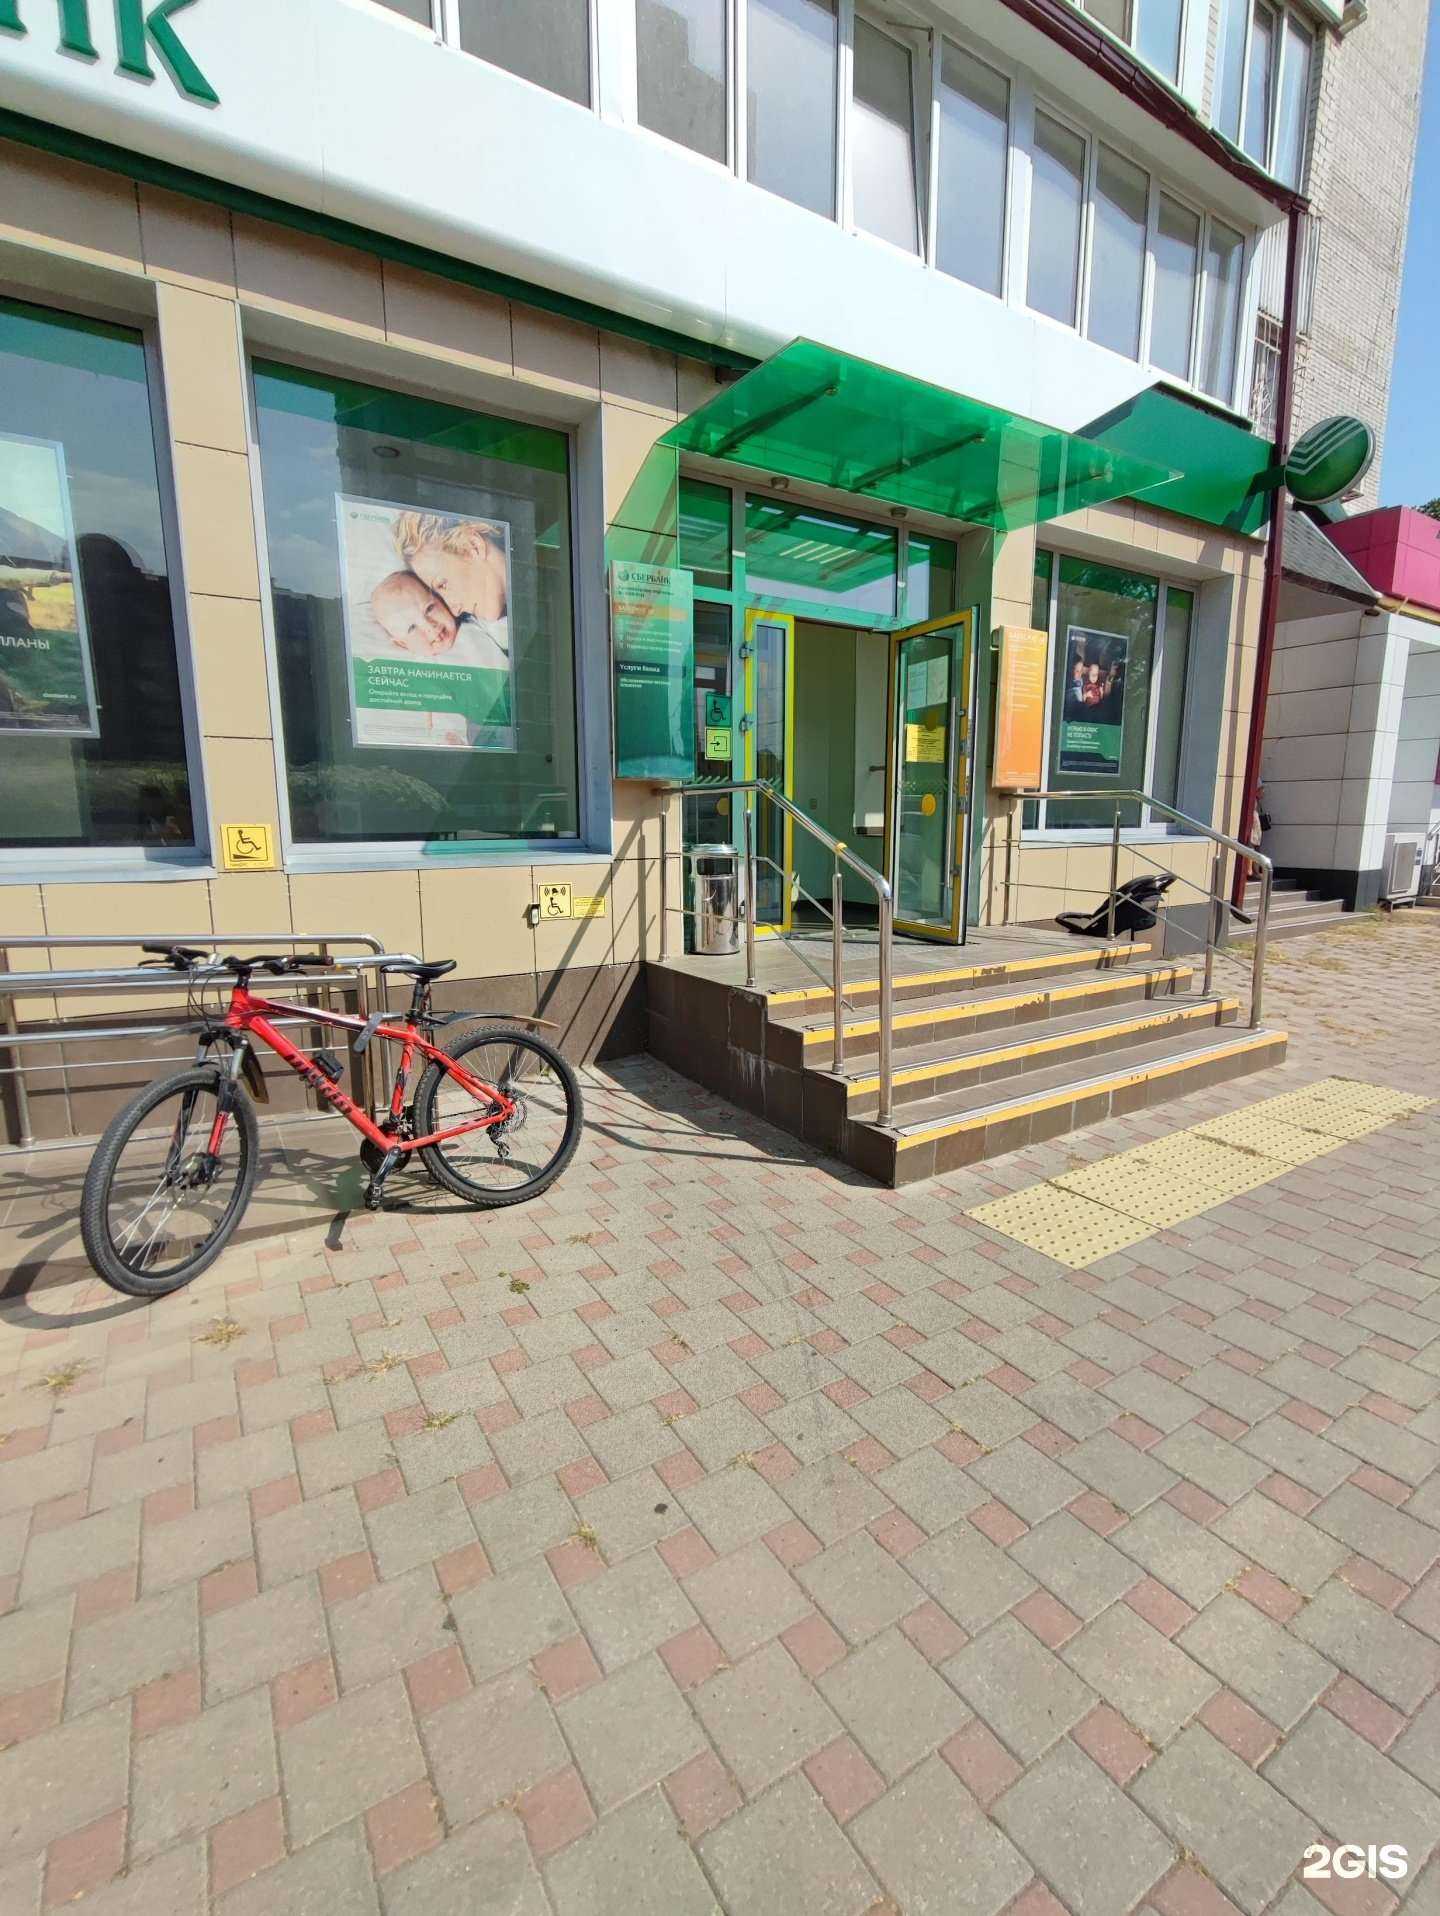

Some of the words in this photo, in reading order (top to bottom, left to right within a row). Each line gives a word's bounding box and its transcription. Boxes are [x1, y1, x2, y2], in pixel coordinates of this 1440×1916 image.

[367, 665, 406, 676] ЗАВТРА
[407, 669, 472, 681] НАЧИНАЕТСЯ
[367, 676, 409, 688] СЕЙЧАС
